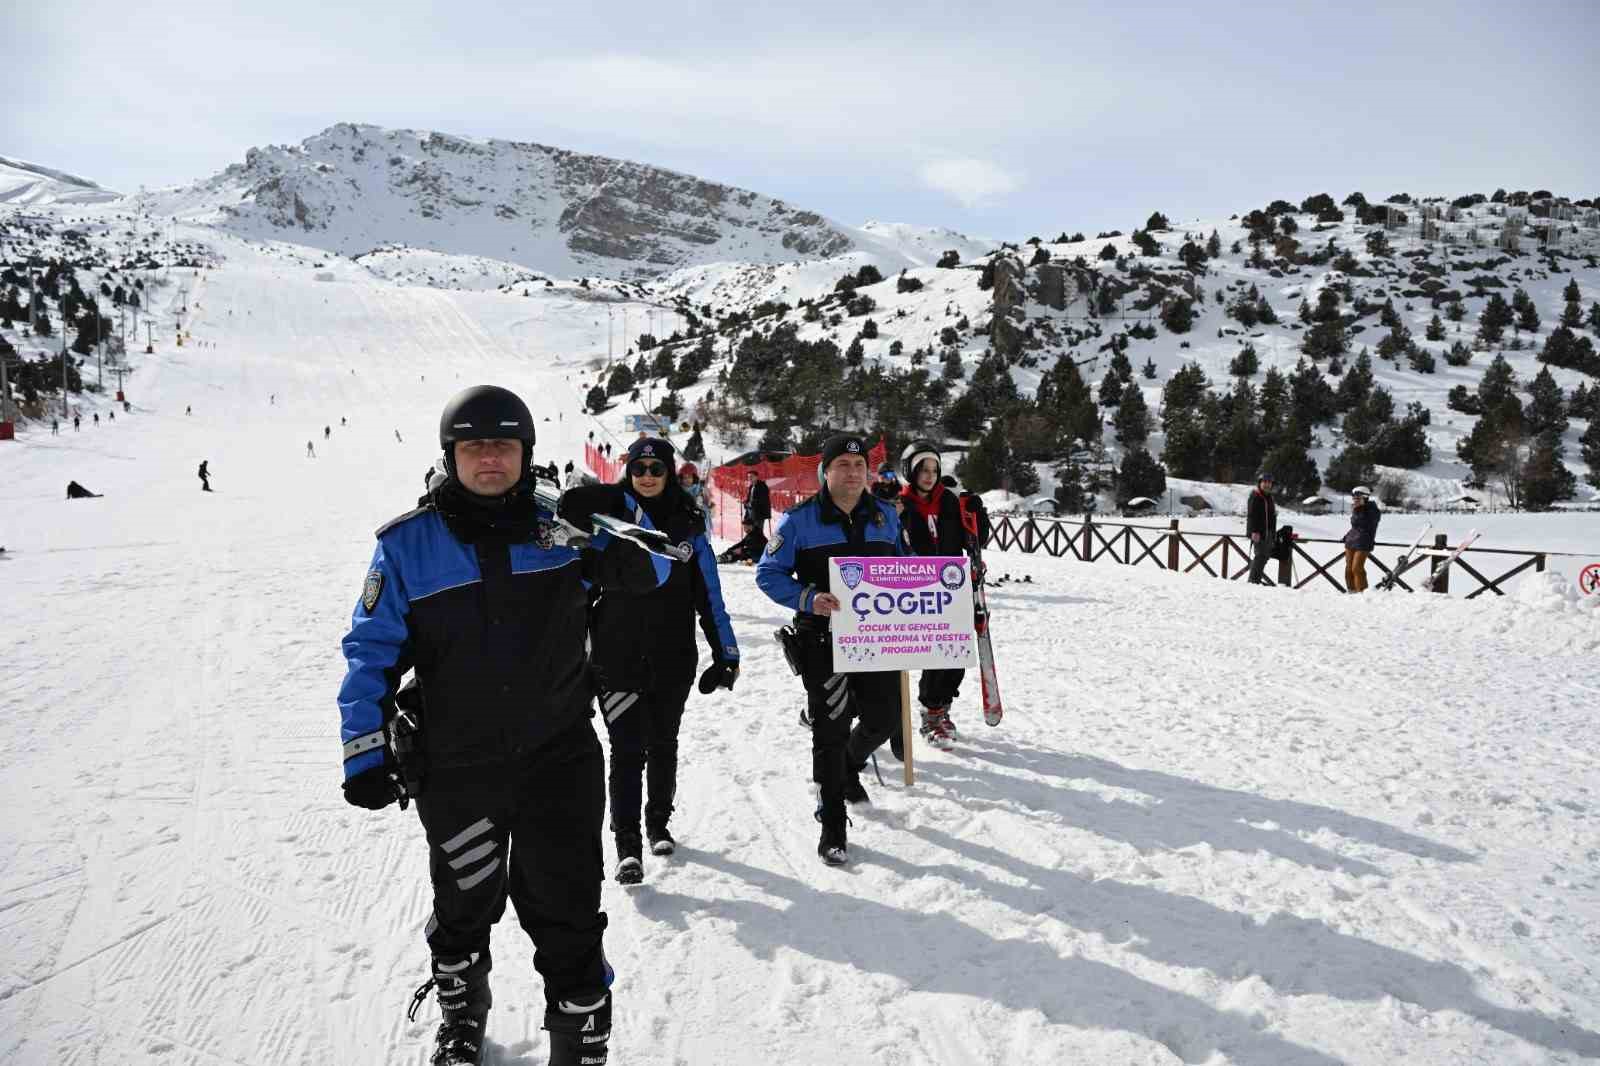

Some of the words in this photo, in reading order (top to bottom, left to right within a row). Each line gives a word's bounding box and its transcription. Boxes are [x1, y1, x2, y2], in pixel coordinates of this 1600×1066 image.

[869, 562, 936, 575] ERZİNCAN
[851, 591, 953, 622] ÇOGEP
[858, 624, 892, 635] ÇOCUK
[894, 624, 906, 632] VE
[907, 623, 950, 633] GENÇLER
[838, 635, 876, 644] SOSYAL
[878, 634, 919, 643] KORUMA
[921, 634, 934, 642] VE
[935, 633, 971, 641] DESTEK
[880, 645, 932, 655] PROGRAMI
